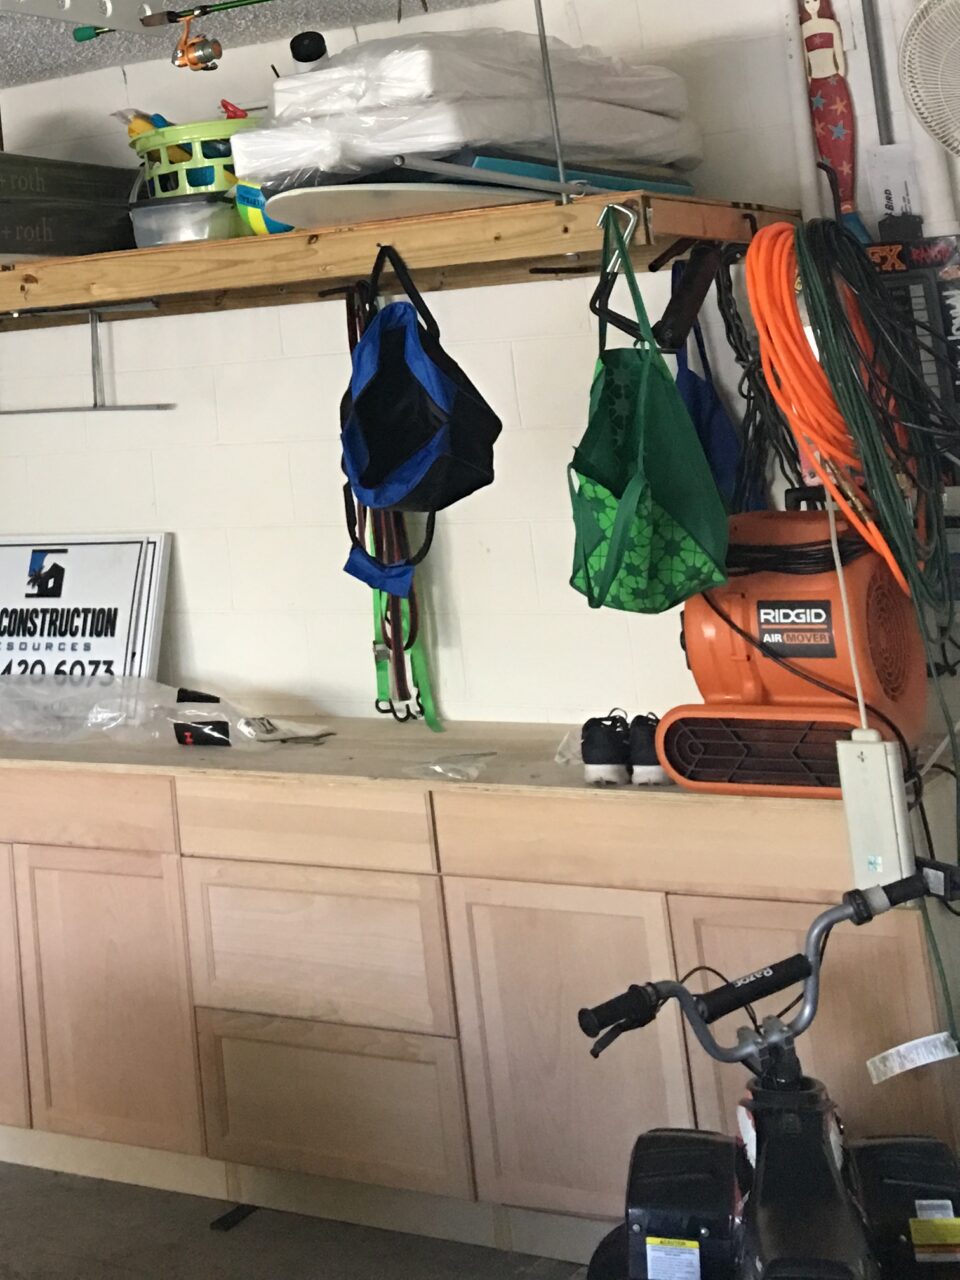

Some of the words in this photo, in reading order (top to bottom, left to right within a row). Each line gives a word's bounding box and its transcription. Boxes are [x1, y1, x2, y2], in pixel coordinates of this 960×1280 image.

[10, 167, 47, 193] roth
[16, 216, 53, 242] roth
[760, 608, 827, 623] RIDGID
[763, 633, 783, 644] AIR
[785, 633, 829, 644] MOVER
[54, 660, 116, 686] 6073
